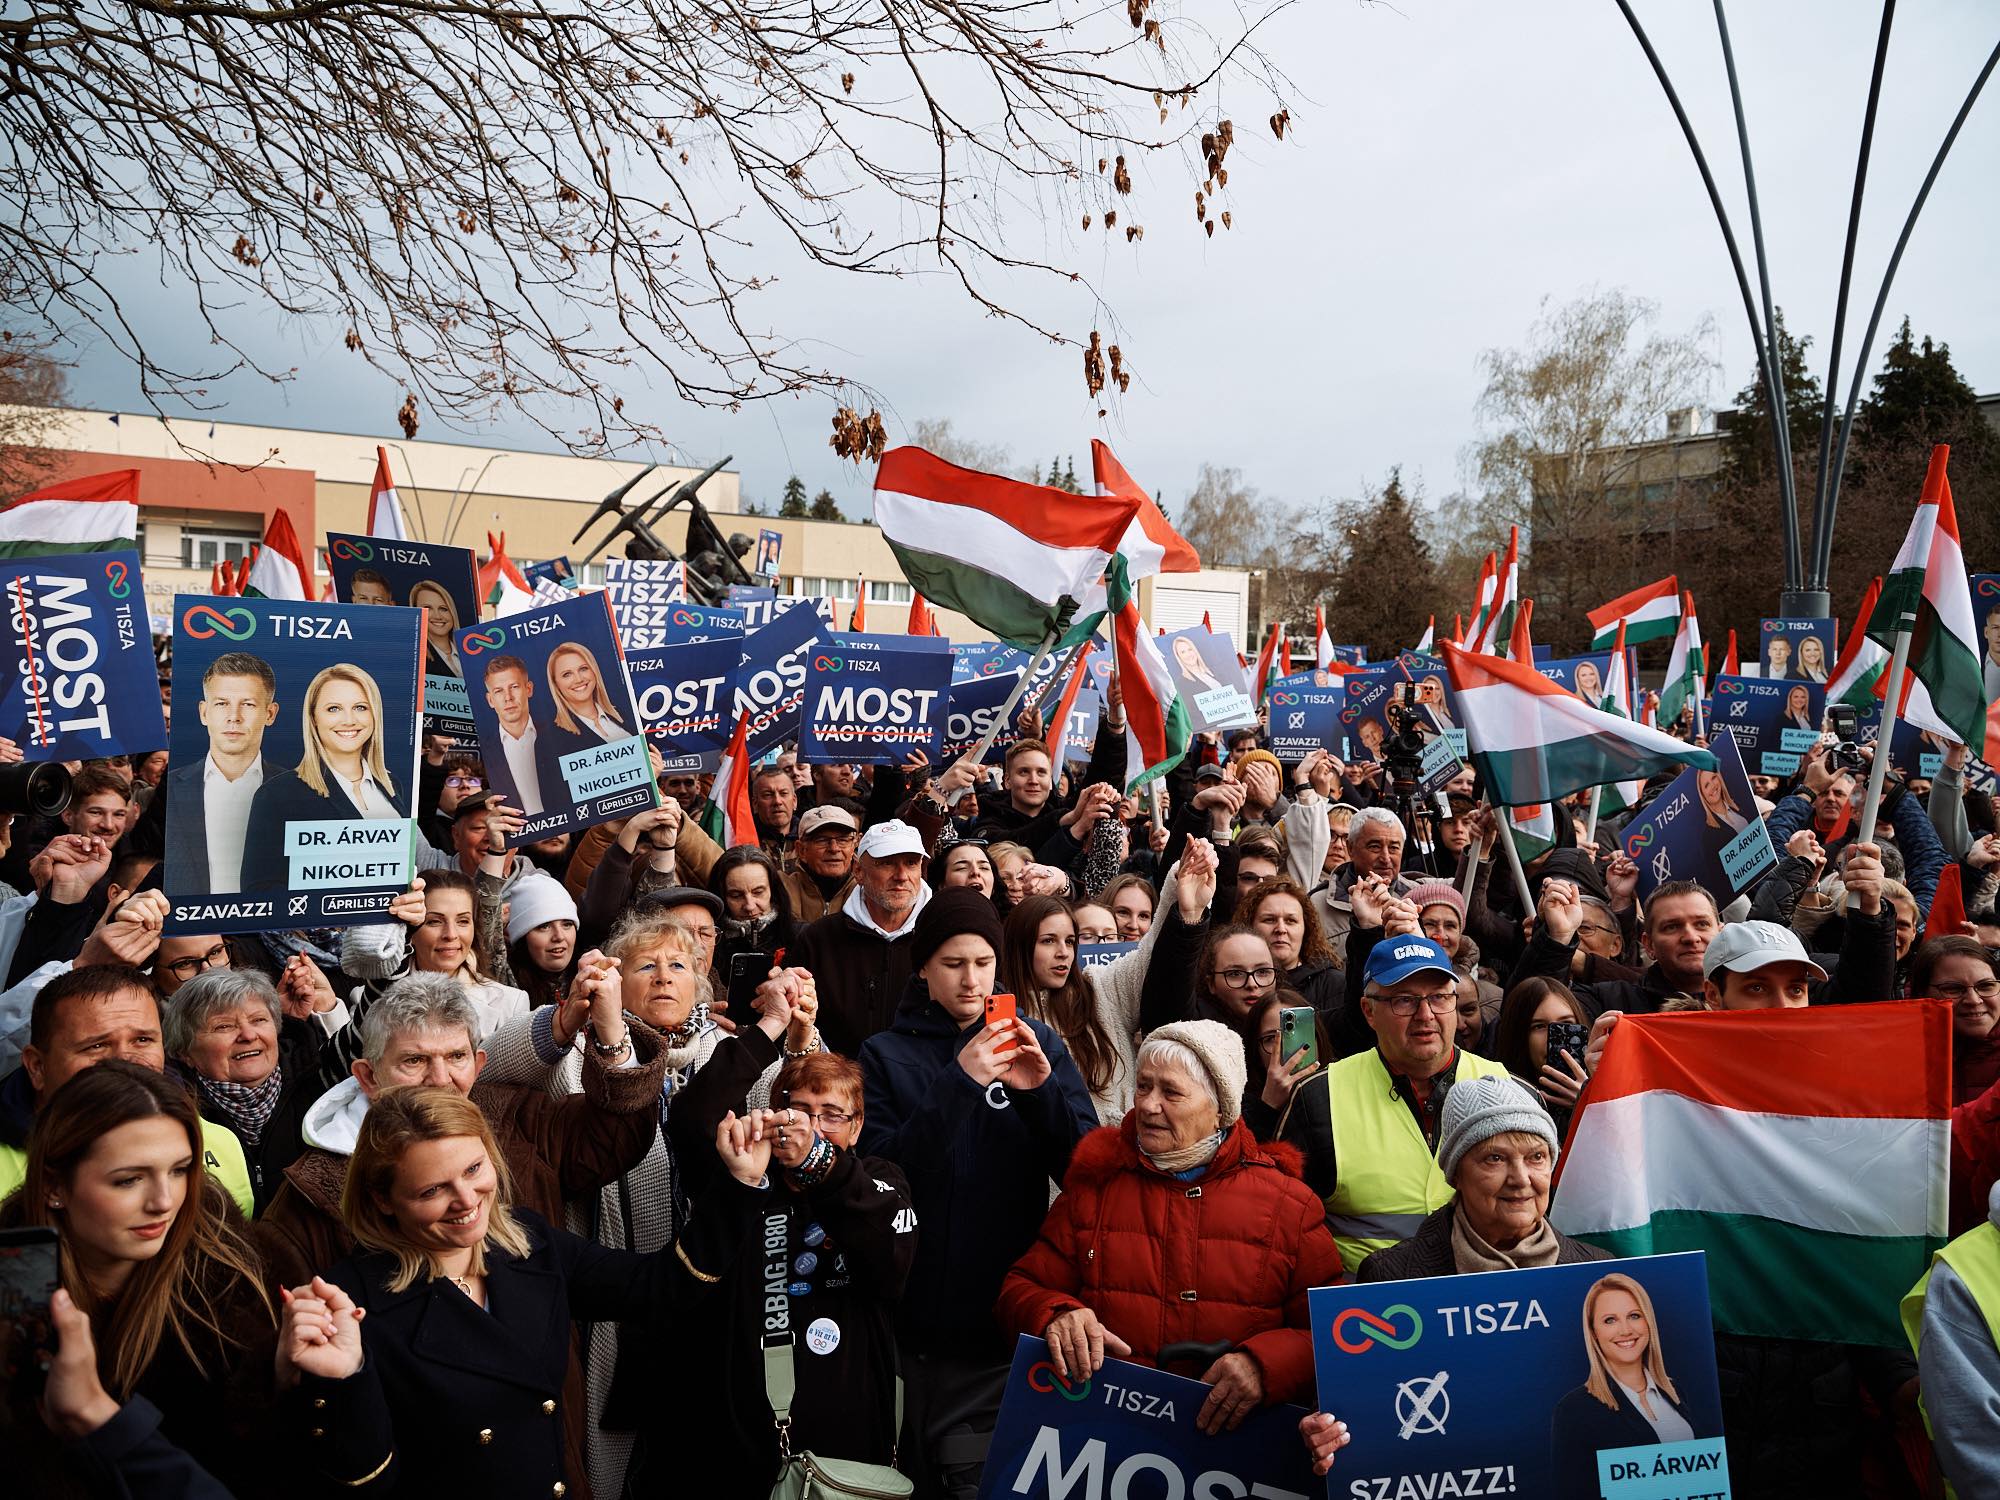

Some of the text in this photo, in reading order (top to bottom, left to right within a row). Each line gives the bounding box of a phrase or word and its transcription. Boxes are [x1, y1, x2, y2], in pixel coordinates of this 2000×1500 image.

[380, 547, 431, 566] TISZA
[606, 560, 684, 581] TISZA
[606, 582, 687, 604] TISZA
[116, 604, 135, 650] TISZA
[269, 615, 353, 640] TISZA
[511, 614, 565, 639] TISZA
[709, 615, 744, 630] TISZA
[1788, 622, 1814, 630] TISZA
[6, 575, 56, 746] VAGY SOHA!
[35, 575, 111, 739] MOST
[629, 659, 664, 672] TISZA
[848, 660, 880, 672] TISZA
[444, 680, 467, 694] ÁRV
[1361, 684, 1387, 706] TISZA
[1749, 685, 1779, 696] TISZA
[427, 700, 471, 714] NIKOLE
[639, 677, 725, 720] OST
[814, 686, 938, 724] MOST
[1303, 695, 1334, 704] TISZA
[813, 724, 932, 744] VAGY SOHA!
[1273, 737, 1320, 746] SZAVAZZ!
[569, 743, 636, 772] DR. ÁRVAY
[578, 767, 642, 795] NIKOLETT
[601, 796, 634, 812] ÁPRILIS
[1655, 792, 1690, 830] TISZA
[298, 827, 401, 846] DR. ÁRVAY
[1724, 825, 1762, 864] DR. ÁRVAY
[302, 862, 400, 880] NIKOLETT
[1732, 845, 1770, 882] NIKOLETT
[175, 902, 273, 922] SZAVAZZ!
[327, 898, 375, 910] ÁPRILIS
[1393, 944, 1435, 960] CAMP
[1437, 1299, 1550, 1337] TISZA
[1103, 1383, 1176, 1422] TISZA
[1609, 1452, 1721, 1481] DR. ÁRVAY
[1350, 1465, 1516, 1500] SZAVAZZ!
